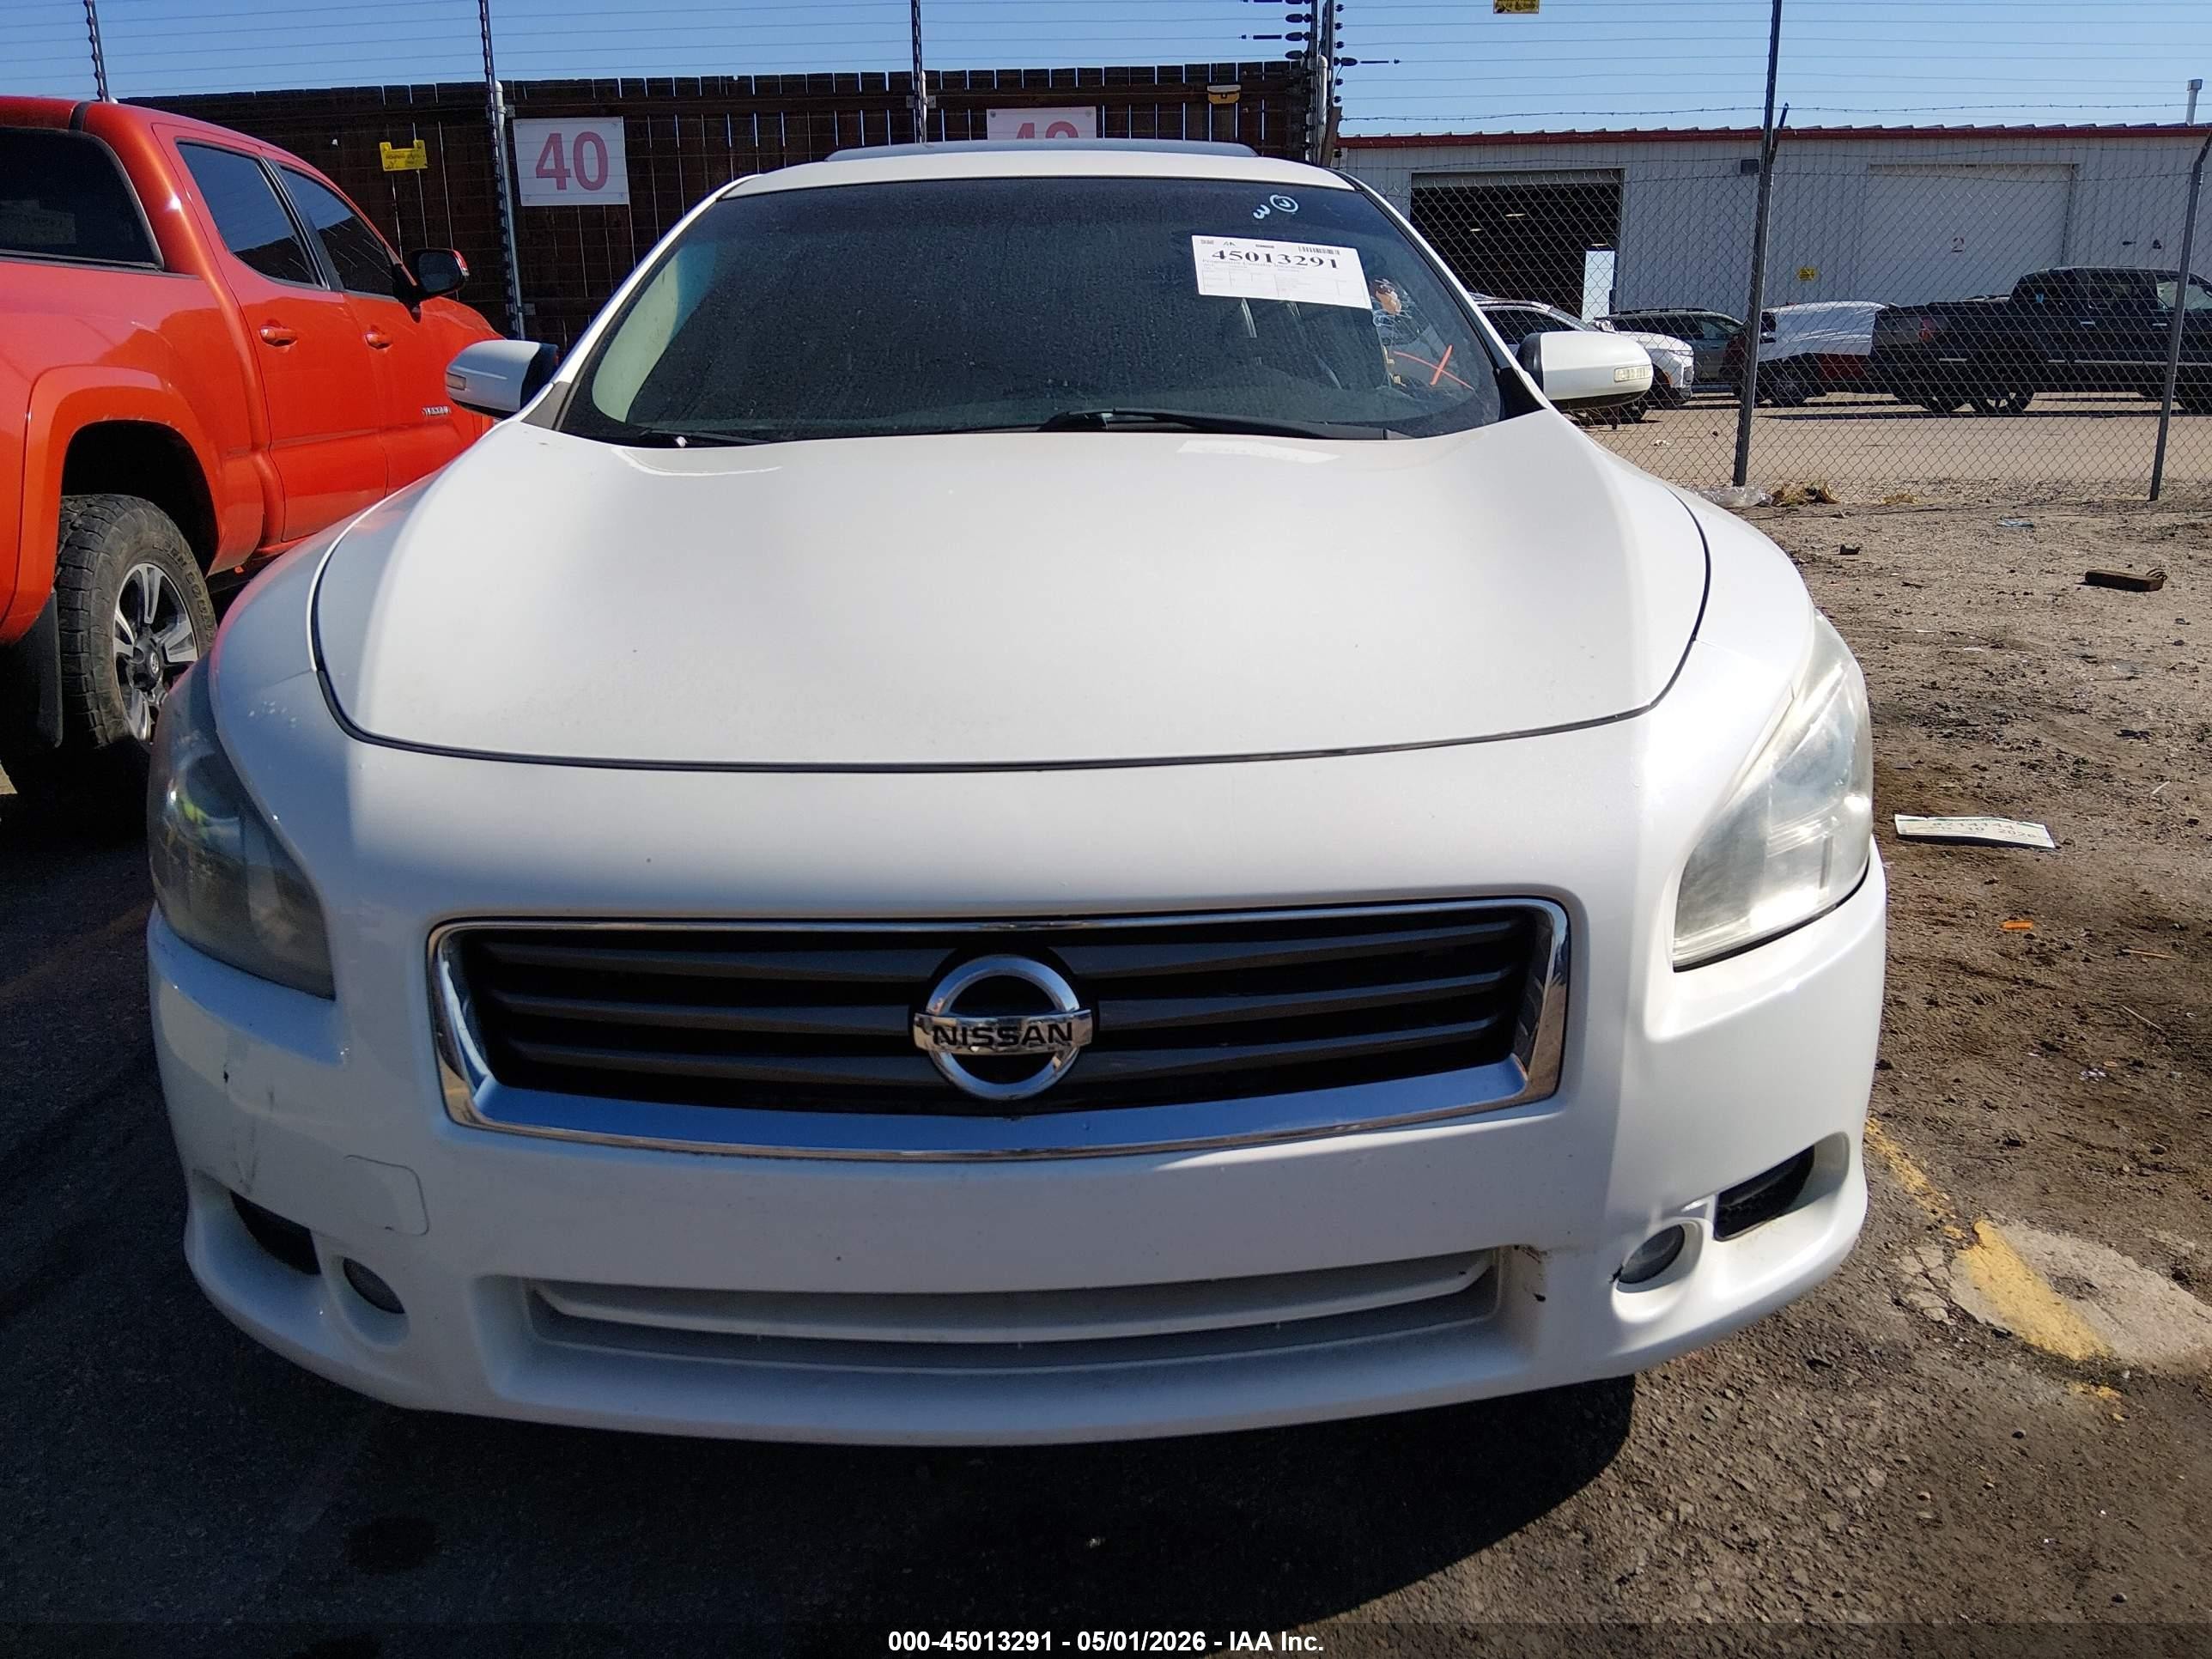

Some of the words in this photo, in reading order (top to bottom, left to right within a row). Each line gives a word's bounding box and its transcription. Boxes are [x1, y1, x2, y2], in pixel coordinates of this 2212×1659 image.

[535, 131, 609, 191] 40
[1212, 250, 1339, 269] 45013291
[932, 1022, 1073, 1047] NISSAN
